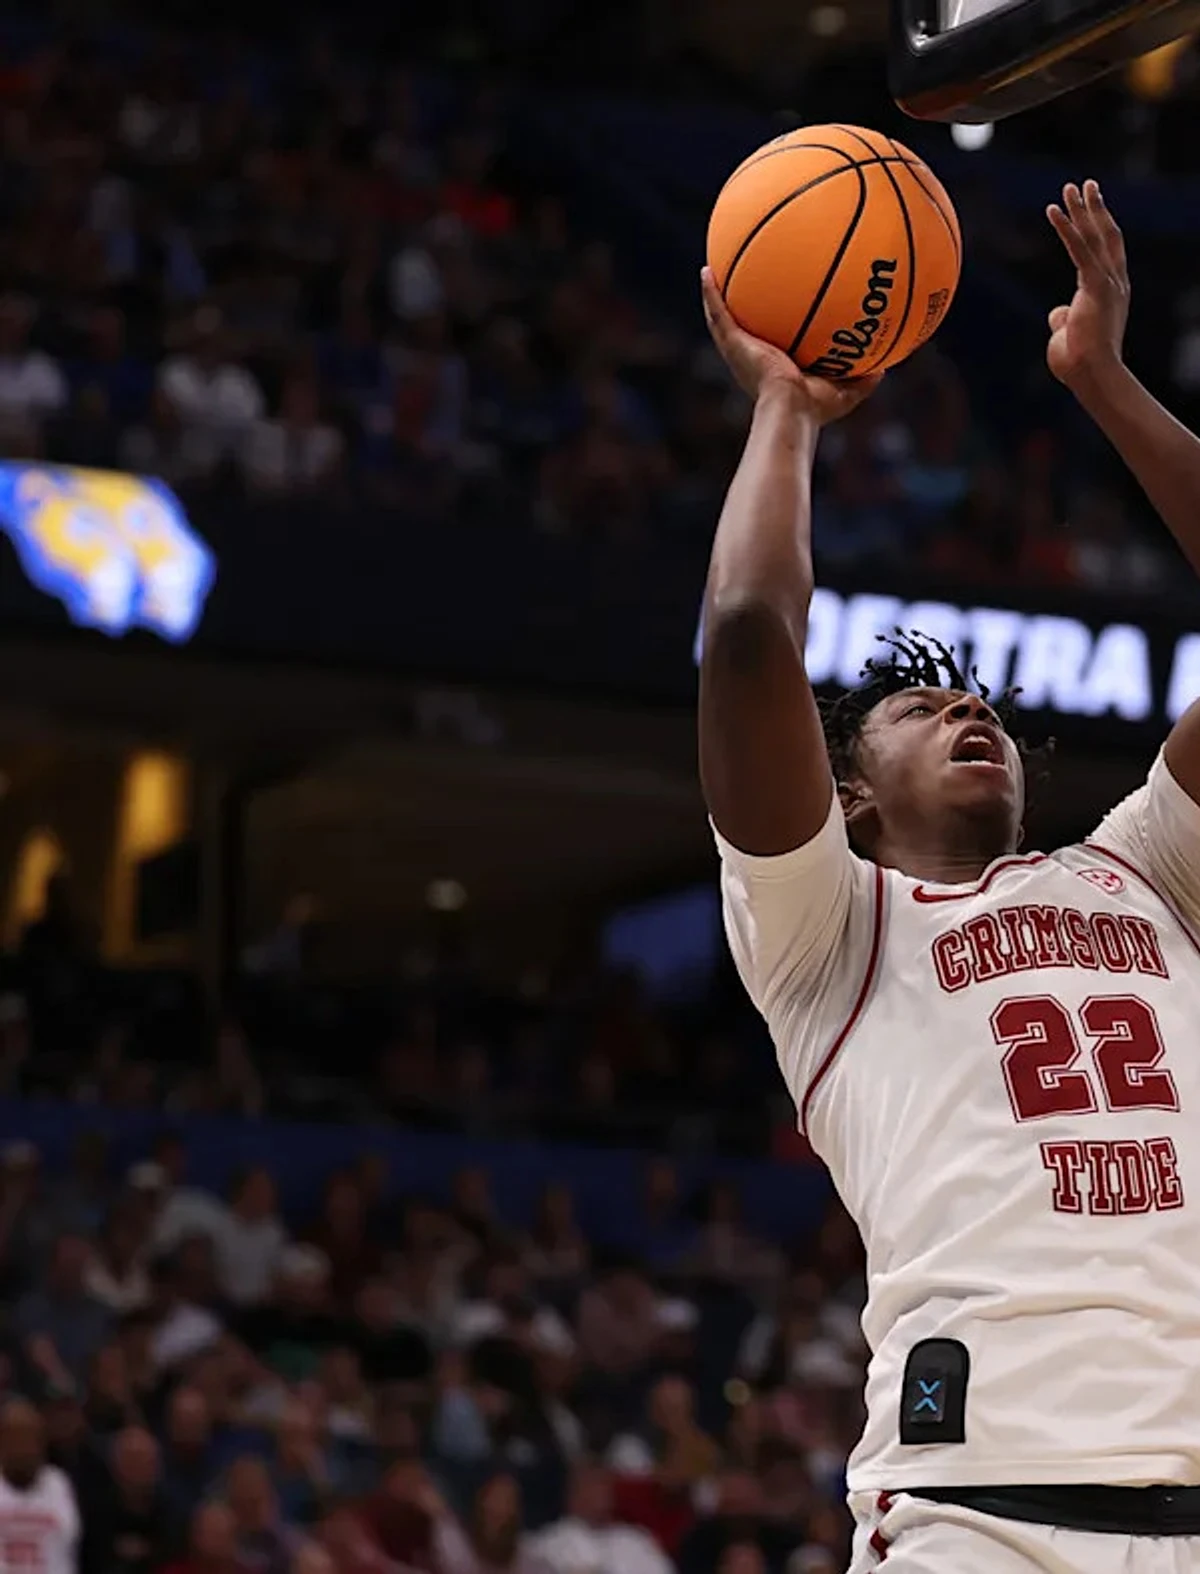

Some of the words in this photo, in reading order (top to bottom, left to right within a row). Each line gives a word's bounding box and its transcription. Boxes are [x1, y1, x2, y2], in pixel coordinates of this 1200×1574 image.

[932, 904, 1170, 993] CRIMSON
[989, 993, 1181, 1123] 22
[1040, 1136, 1184, 1216] TIDE
